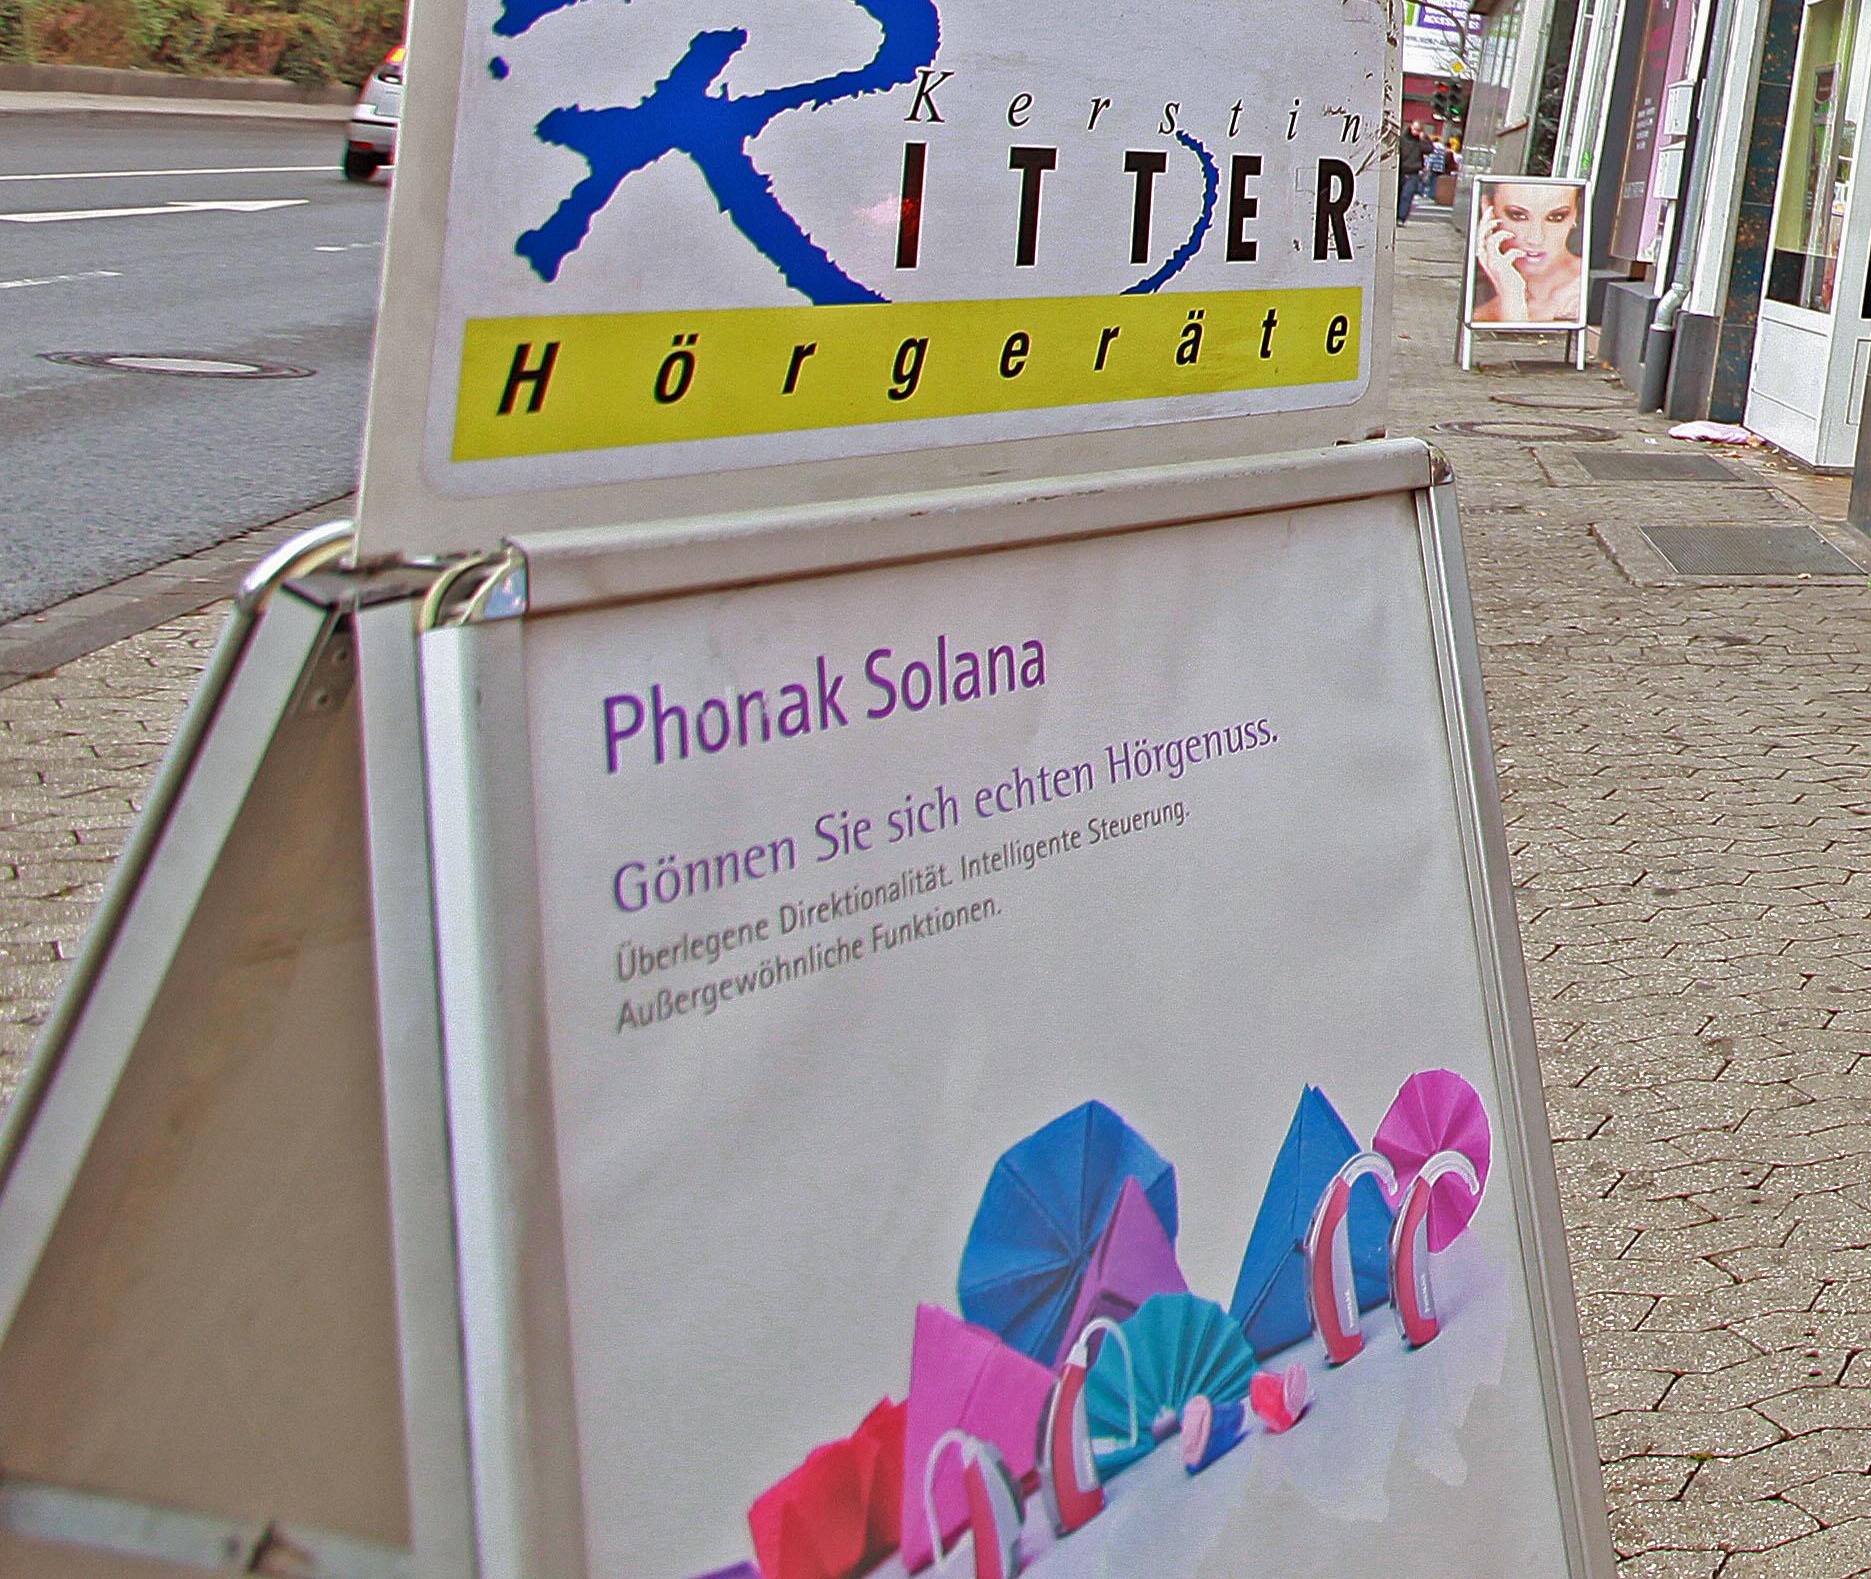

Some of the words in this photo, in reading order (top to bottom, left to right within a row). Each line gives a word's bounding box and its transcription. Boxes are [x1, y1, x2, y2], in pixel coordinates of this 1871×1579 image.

[907, 69, 1362, 145] Kerstin
[497, 308, 1348, 415] Hörgeräte
[603, 653, 849, 775] Phonak
[866, 635, 1047, 721] Solana
[613, 828, 797, 914] Gönnen
[815, 812, 874, 863] Sie
[887, 786, 960, 843] sich
[974, 760, 1096, 821] echten
[1105, 716, 1280, 788] Hörgenuss.
[615, 913, 771, 984] Überlegene
[779, 866, 953, 934] Direktionalität.
[959, 827, 1083, 882] Intelligente
[1088, 798, 1191, 847] Steuerung.
[615, 934, 865, 1034] Außergewöhnliche
[870, 896, 1002, 958] Funktionen.
